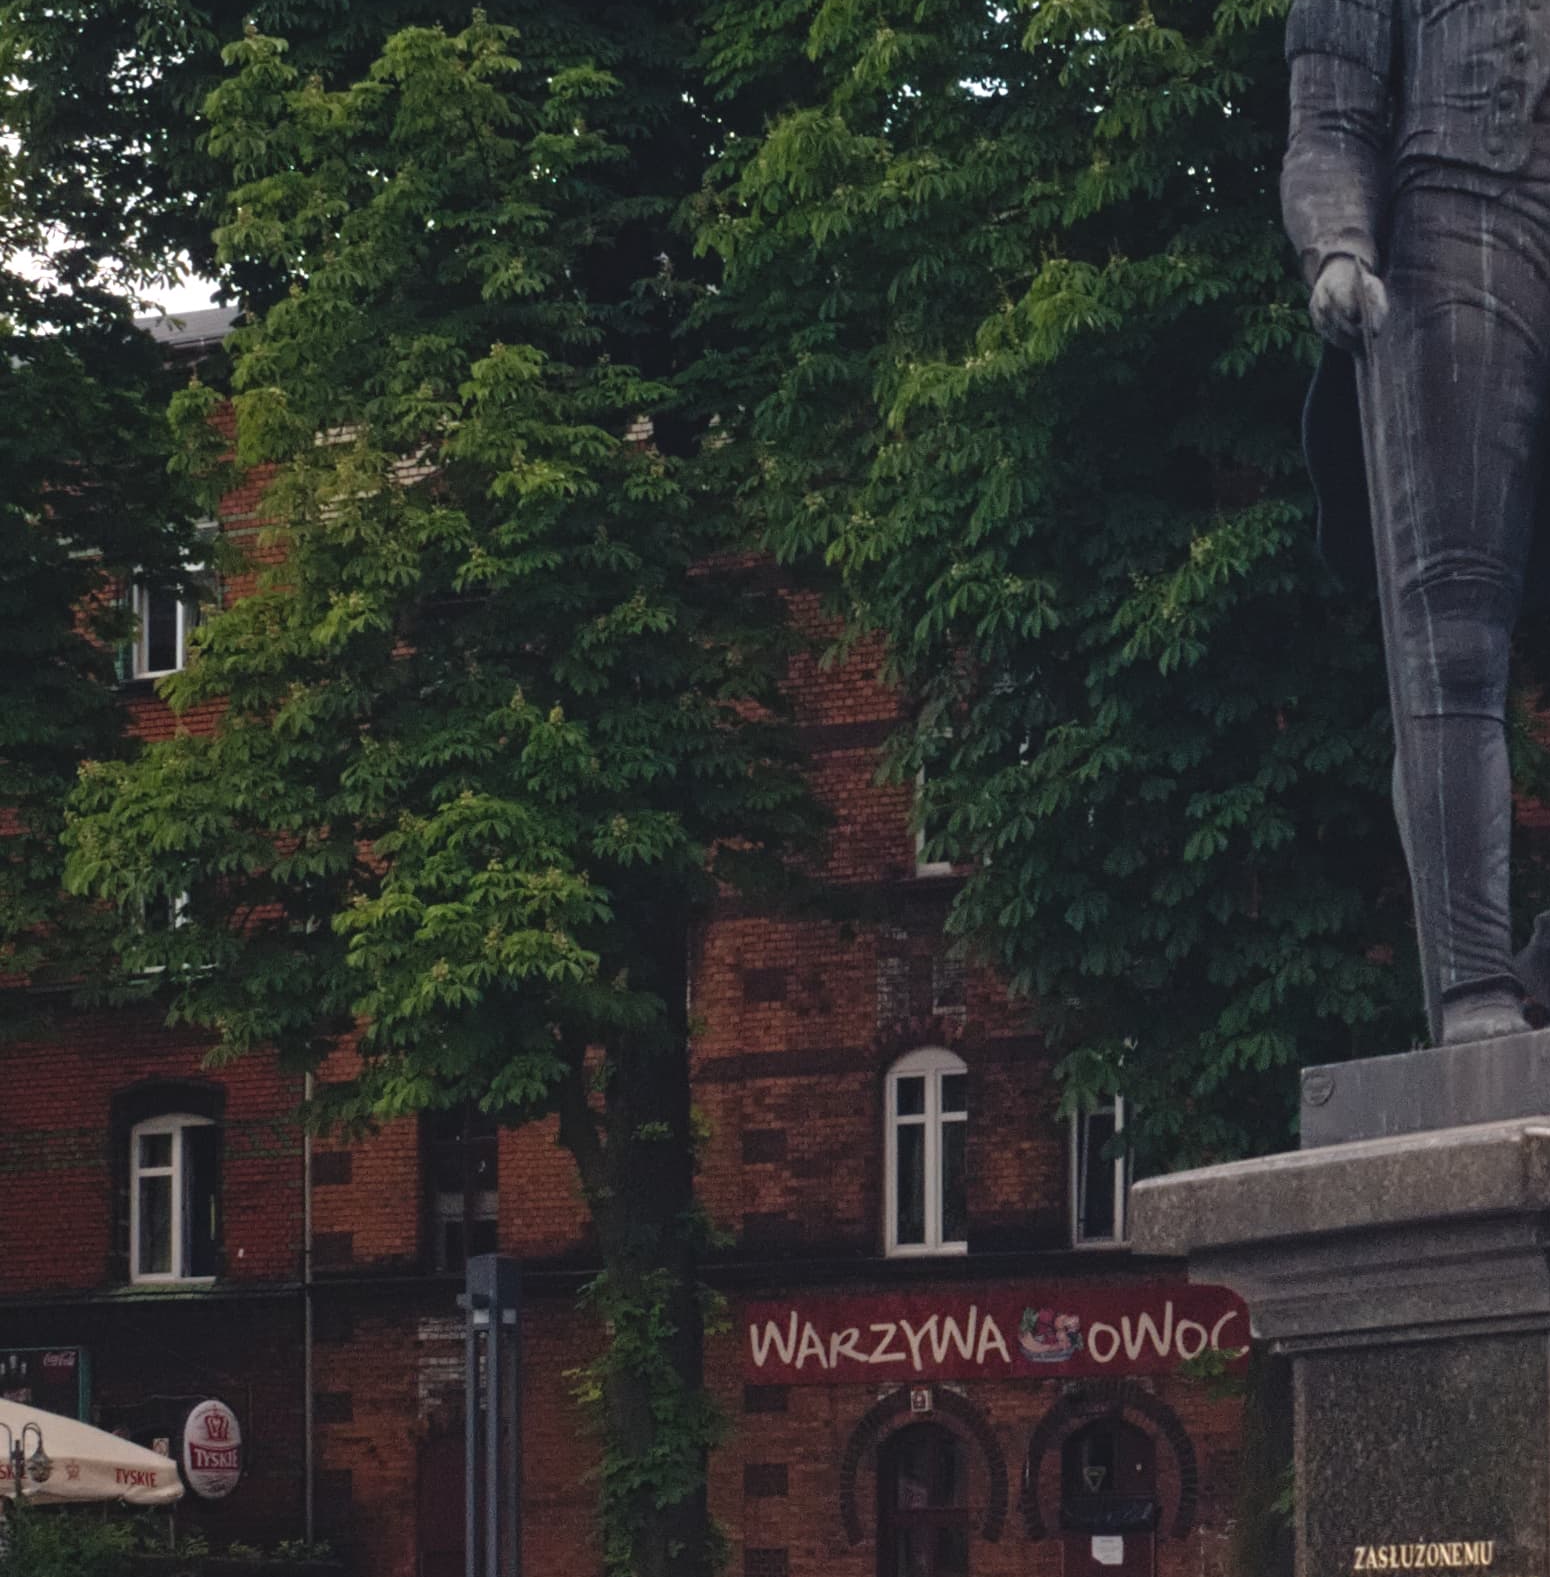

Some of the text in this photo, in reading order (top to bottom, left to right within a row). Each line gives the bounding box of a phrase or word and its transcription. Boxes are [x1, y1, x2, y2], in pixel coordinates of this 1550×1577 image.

[750, 1305, 1010, 1371] WARZYWA
[194, 1449, 238, 1468] TYSKIE
[115, 1468, 157, 1488] TYSKIE
[1354, 1536, 1495, 1571] ZASŁUŻONEMU
